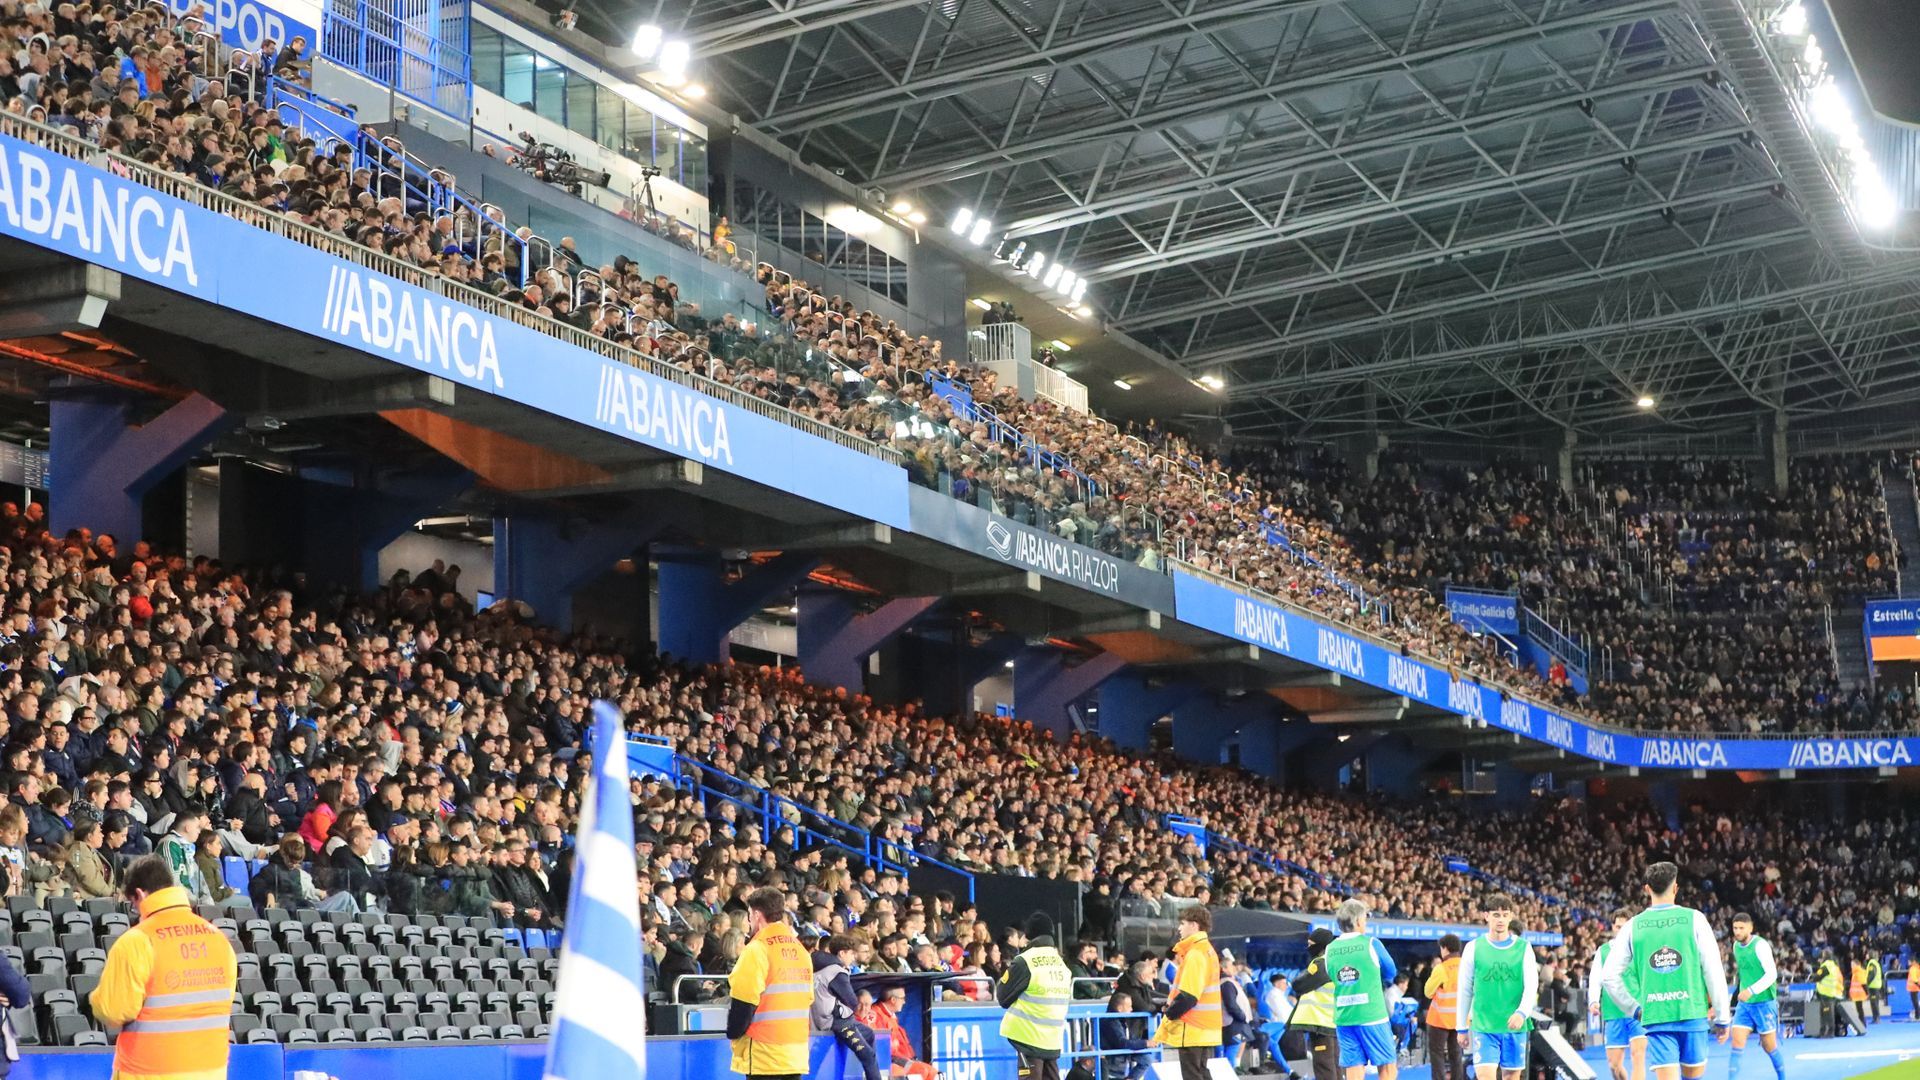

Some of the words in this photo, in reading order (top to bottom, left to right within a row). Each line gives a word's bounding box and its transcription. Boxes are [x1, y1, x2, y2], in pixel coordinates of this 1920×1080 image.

[1072, 550, 1119, 593] RIAZOR
[1872, 609, 1914, 622] Estrella
[156, 924, 216, 939] STEWAR
[180, 942, 208, 960] 051
